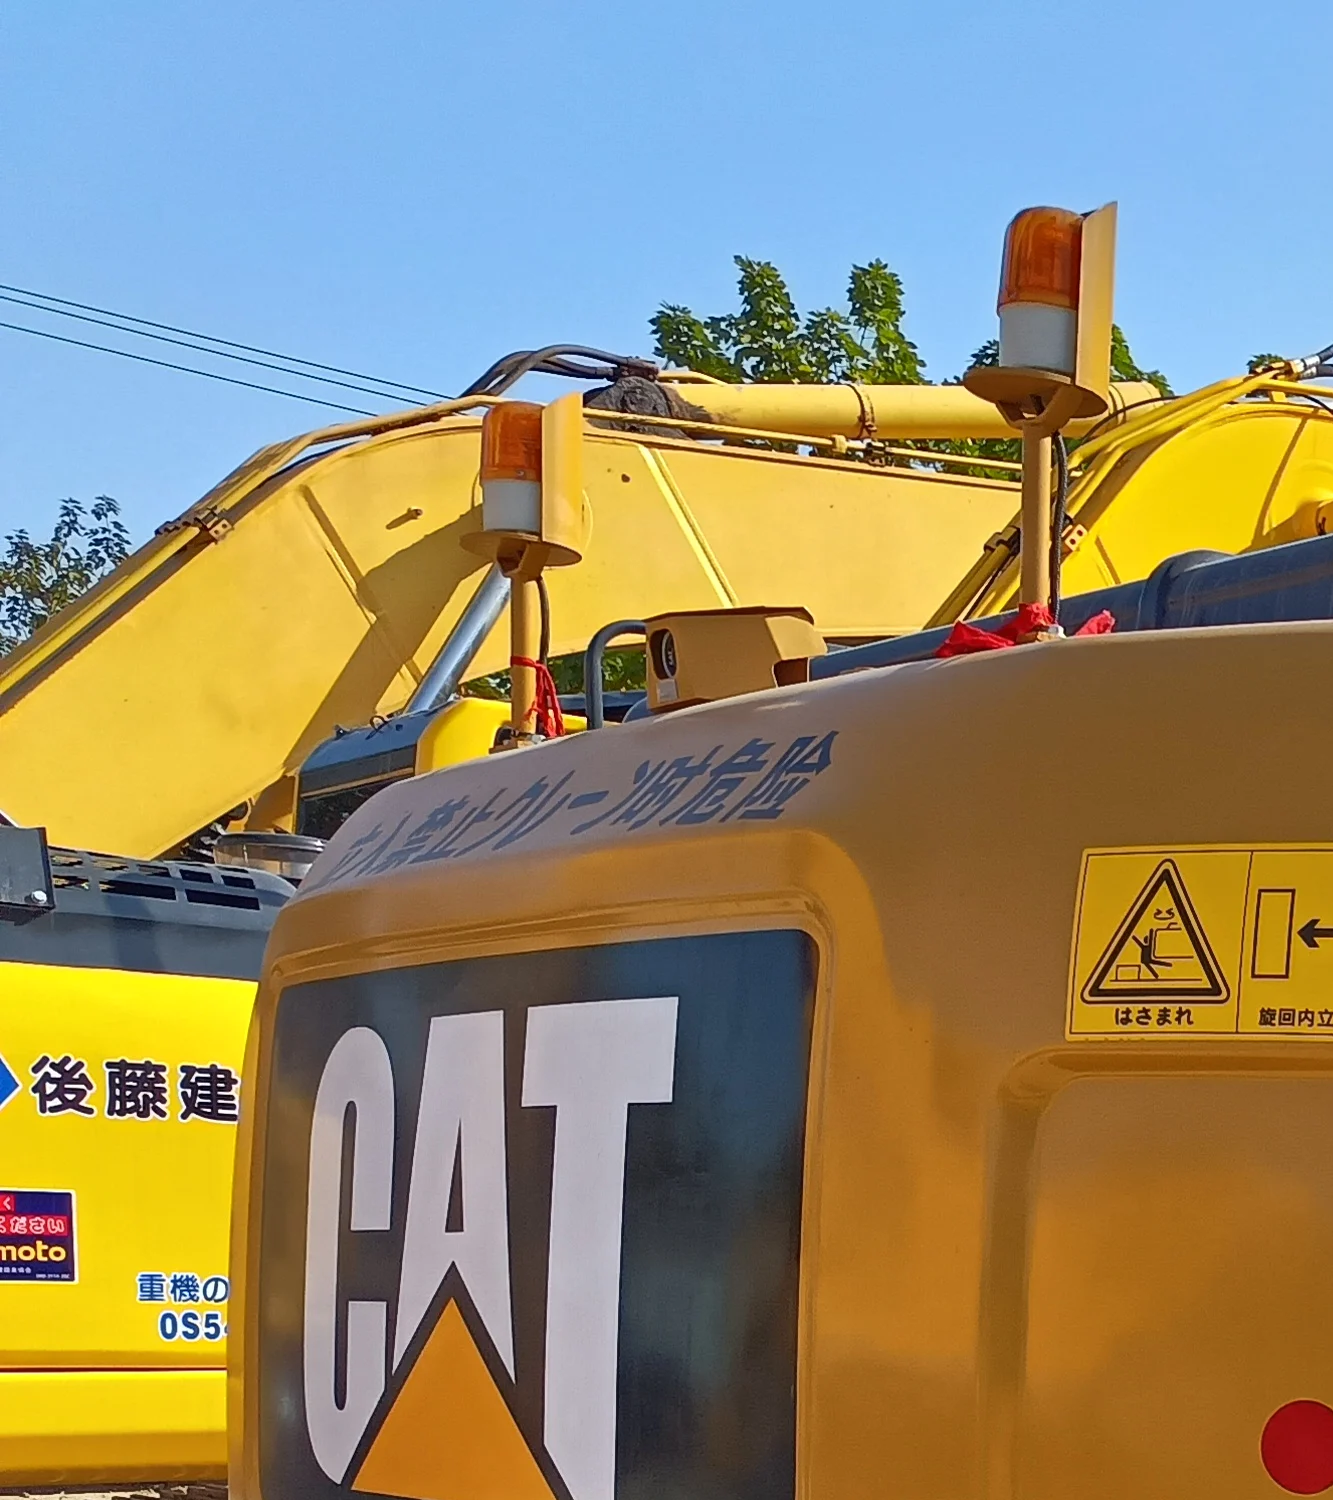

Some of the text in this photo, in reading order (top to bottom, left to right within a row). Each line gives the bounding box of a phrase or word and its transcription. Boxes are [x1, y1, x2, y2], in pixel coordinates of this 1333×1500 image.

[1115, 1006, 1194, 1027] はさまれ
[31, 1055, 239, 1122] 後藤建
[138, 1274, 229, 1303] 重機の
[159, 1312, 229, 1340] 0S5
